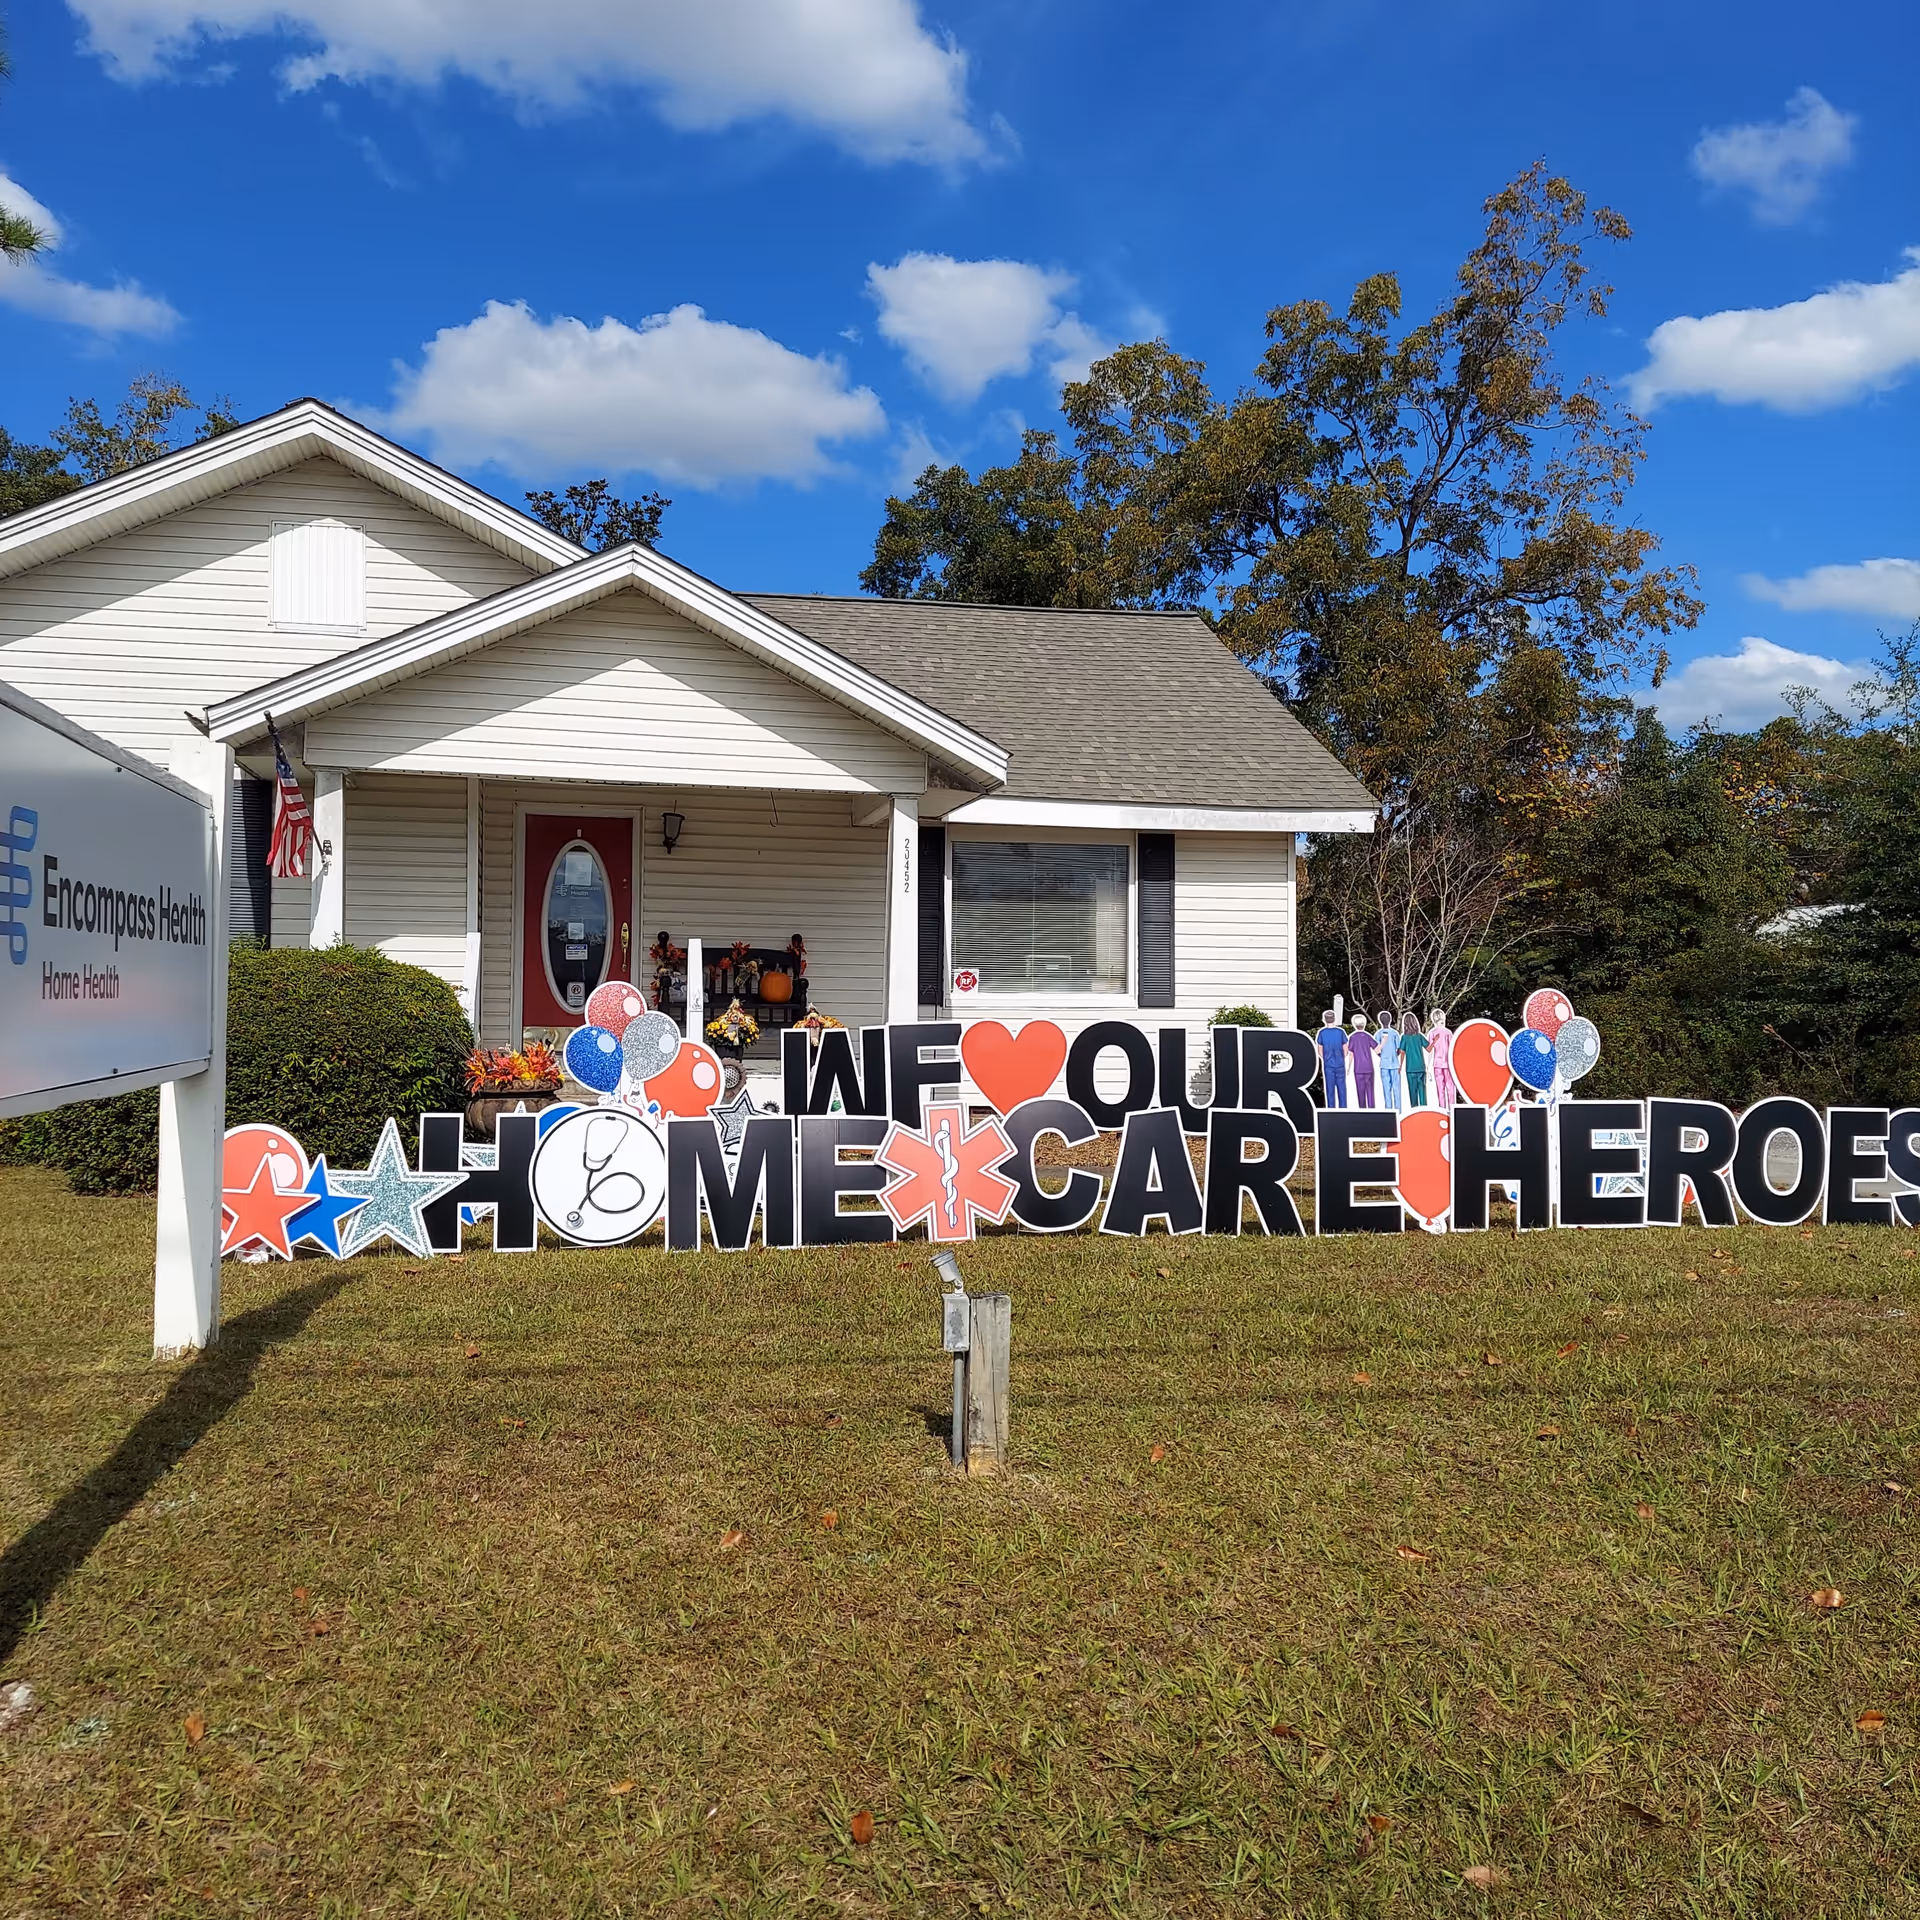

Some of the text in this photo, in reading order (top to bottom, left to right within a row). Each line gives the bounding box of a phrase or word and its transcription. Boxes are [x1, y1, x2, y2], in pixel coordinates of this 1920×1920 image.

[43, 854, 206, 952] Encompass Health
[42, 961, 120, 1000] Home Health
[781, 1020, 1320, 1136] WE OUR
[998, 1097, 1405, 1237] CARE
